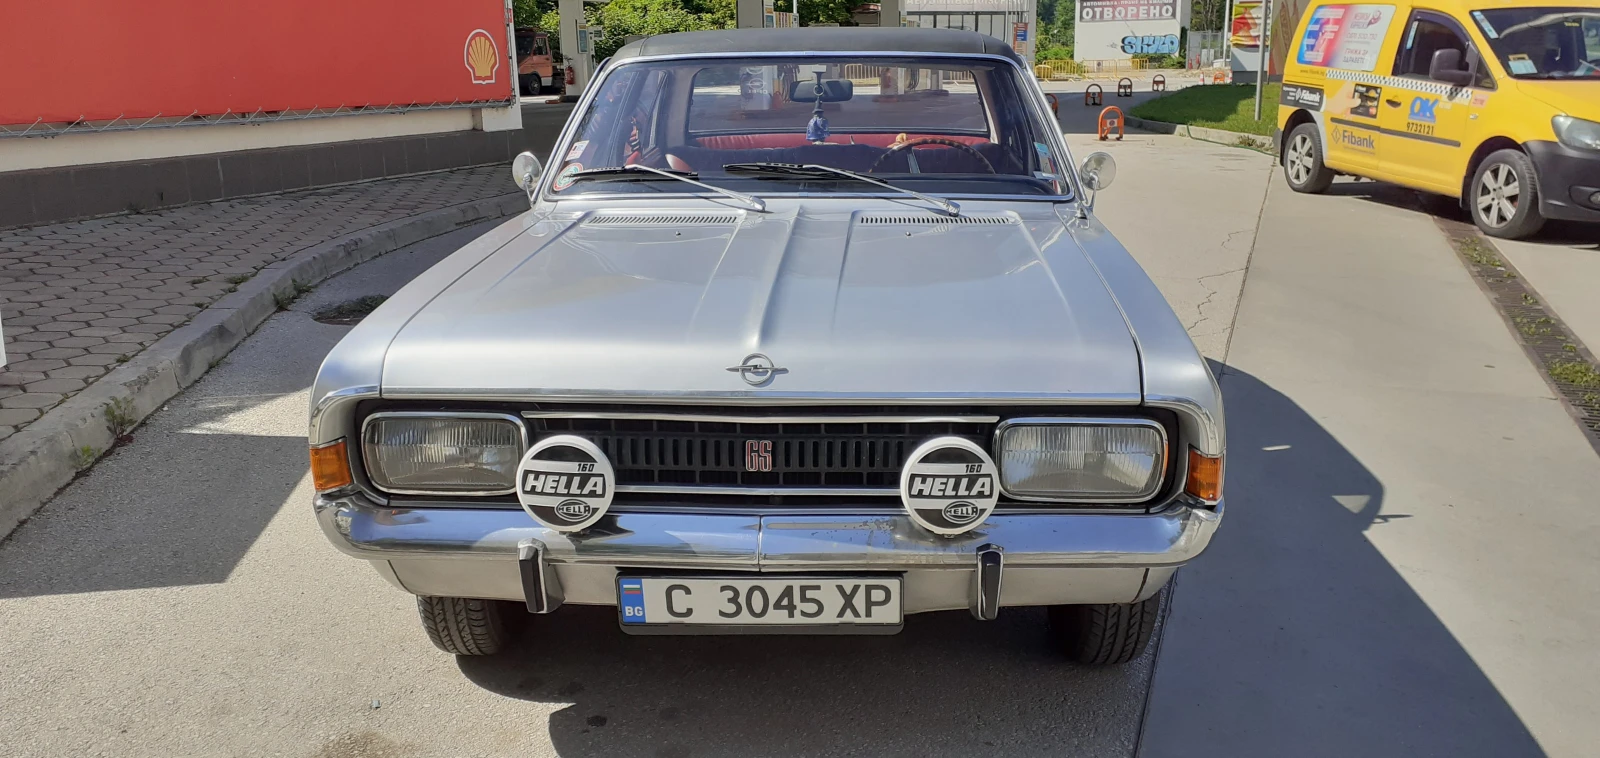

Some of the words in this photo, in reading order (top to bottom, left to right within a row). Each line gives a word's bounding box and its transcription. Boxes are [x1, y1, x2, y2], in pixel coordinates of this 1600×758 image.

[1082, 4, 1173, 19] ОТВОРЕНО
[1300, 90, 1321, 102] Fibank
[1406, 122, 1434, 135] 9732121
[1342, 129, 1375, 149] Fibank
[745, 439, 772, 472] GS
[577, 463, 595, 472] 160
[965, 464, 983, 473] 160
[524, 473, 604, 495] HELLA
[910, 477, 991, 496] HELLA
[558, 503, 591, 515] HELLA
[946, 506, 979, 516] HELLA
[665, 584, 694, 618] C
[718, 585, 825, 619] 3045
[836, 584, 892, 618] XP
[625, 606, 643, 617] BG
